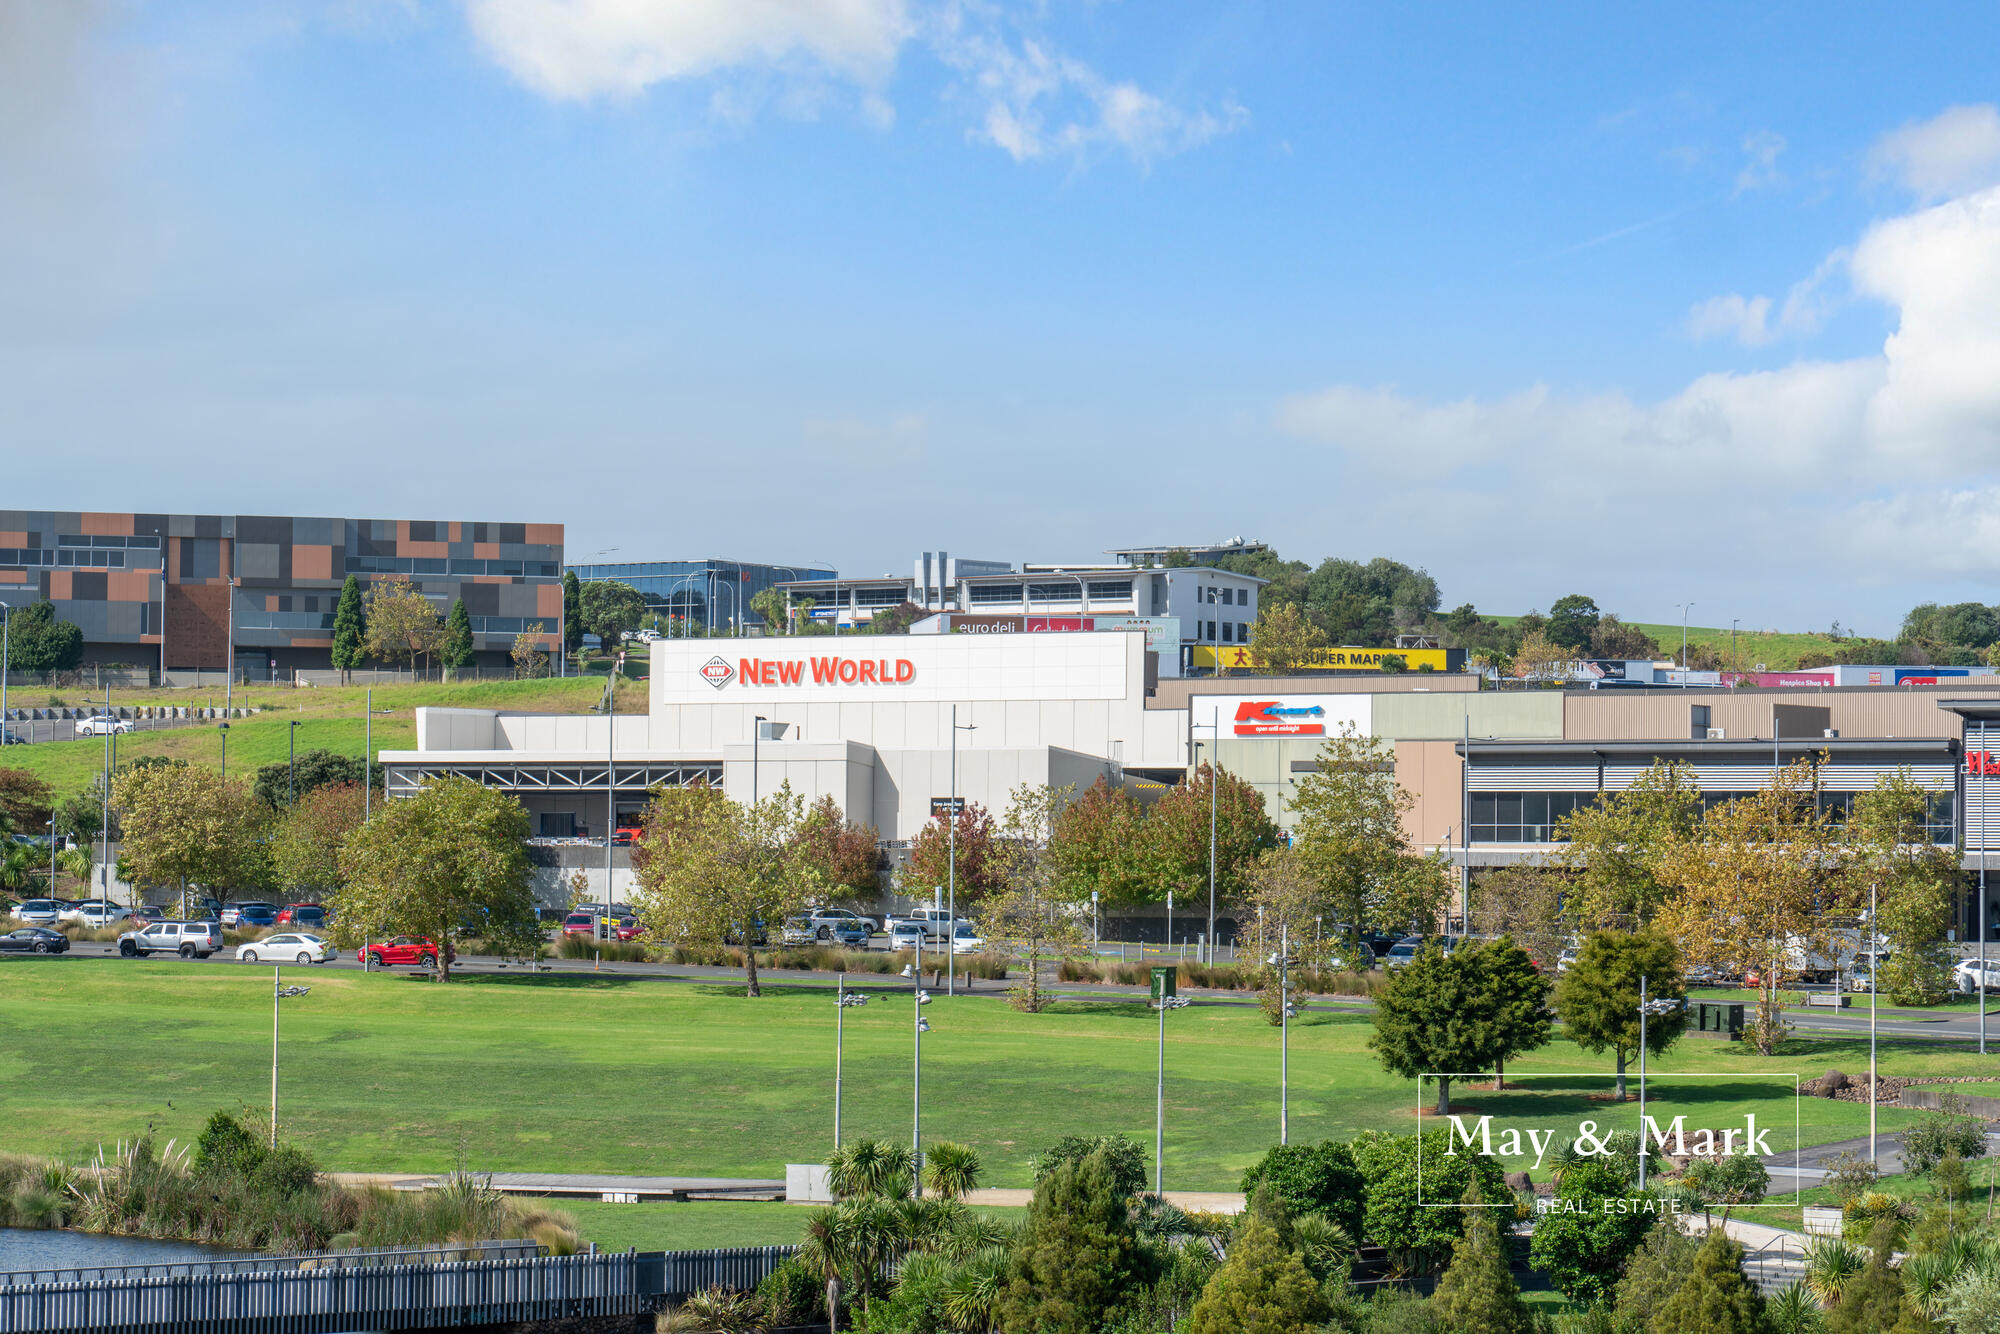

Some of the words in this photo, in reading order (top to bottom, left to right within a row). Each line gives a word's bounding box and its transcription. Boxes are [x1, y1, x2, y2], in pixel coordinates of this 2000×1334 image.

[960, 622, 989, 633] euro
[991, 621, 1016, 633] deli
[707, 666, 727, 677] NW
[739, 658, 804, 685] NEW
[810, 656, 915, 684] WORLD
